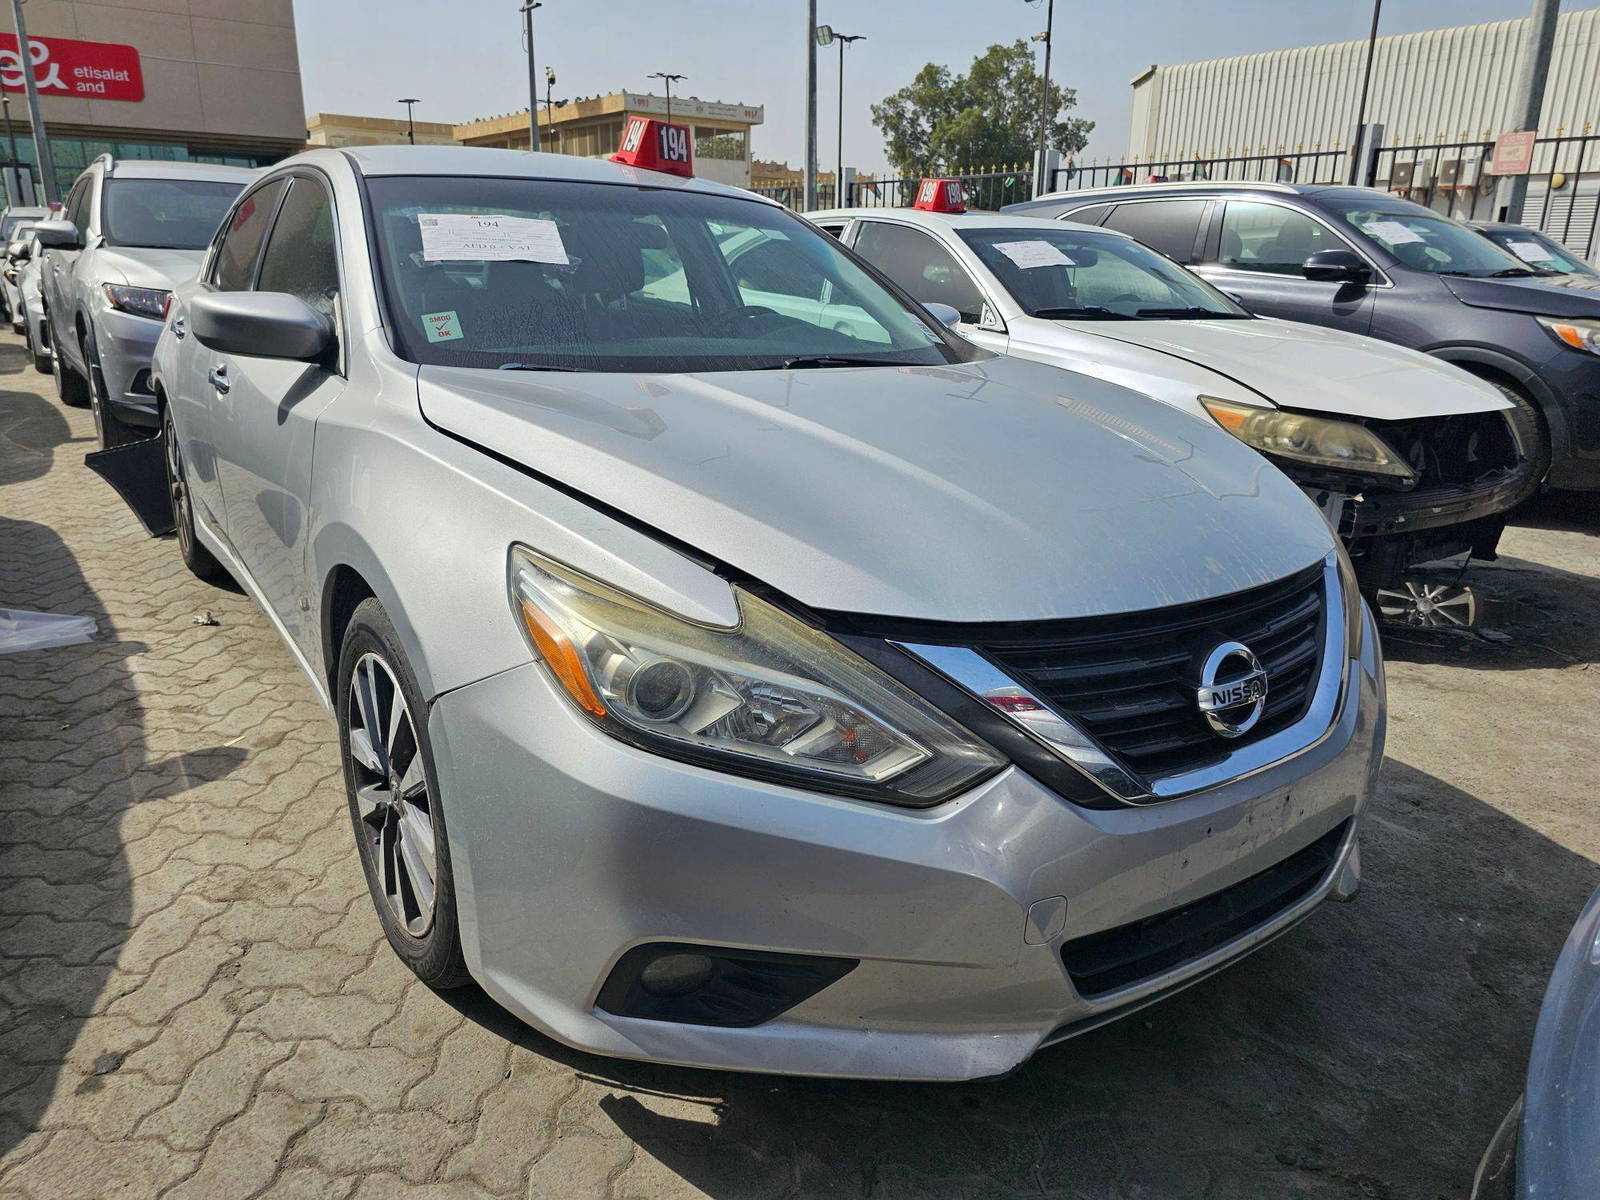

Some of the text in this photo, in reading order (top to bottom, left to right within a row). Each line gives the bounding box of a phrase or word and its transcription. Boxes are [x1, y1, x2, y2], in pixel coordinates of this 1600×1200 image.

[73, 66, 130, 82] etisalat
[76, 81, 105, 94] and
[622, 120, 646, 153] 194
[660, 126, 688, 163] 194
[920, 181, 938, 203] 198
[947, 182, 962, 205] 198
[477, 220, 500, 228] 194
[438, 330, 452, 338] OK
